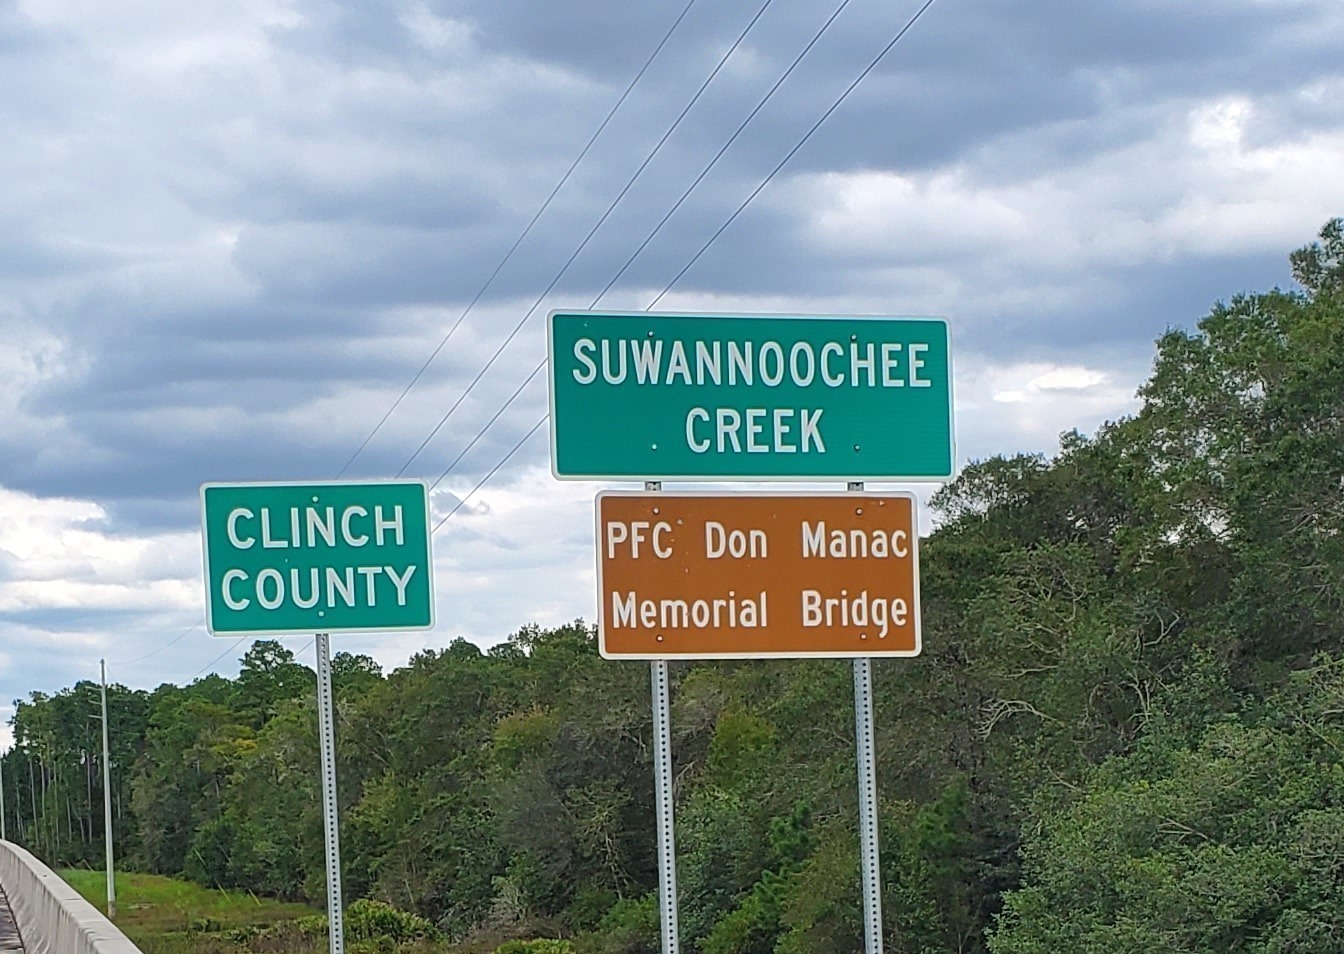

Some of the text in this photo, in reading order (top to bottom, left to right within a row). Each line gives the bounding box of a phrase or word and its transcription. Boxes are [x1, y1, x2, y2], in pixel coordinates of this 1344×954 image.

[572, 338, 931, 387] SUWANNOOCHEE
[686, 407, 826, 453] CREEK
[227, 505, 404, 549] CLINCH
[607, 521, 908, 559] PFC Don Manac
[222, 566, 416, 610] COUNTY
[612, 589, 907, 639] Memorial Bridge
